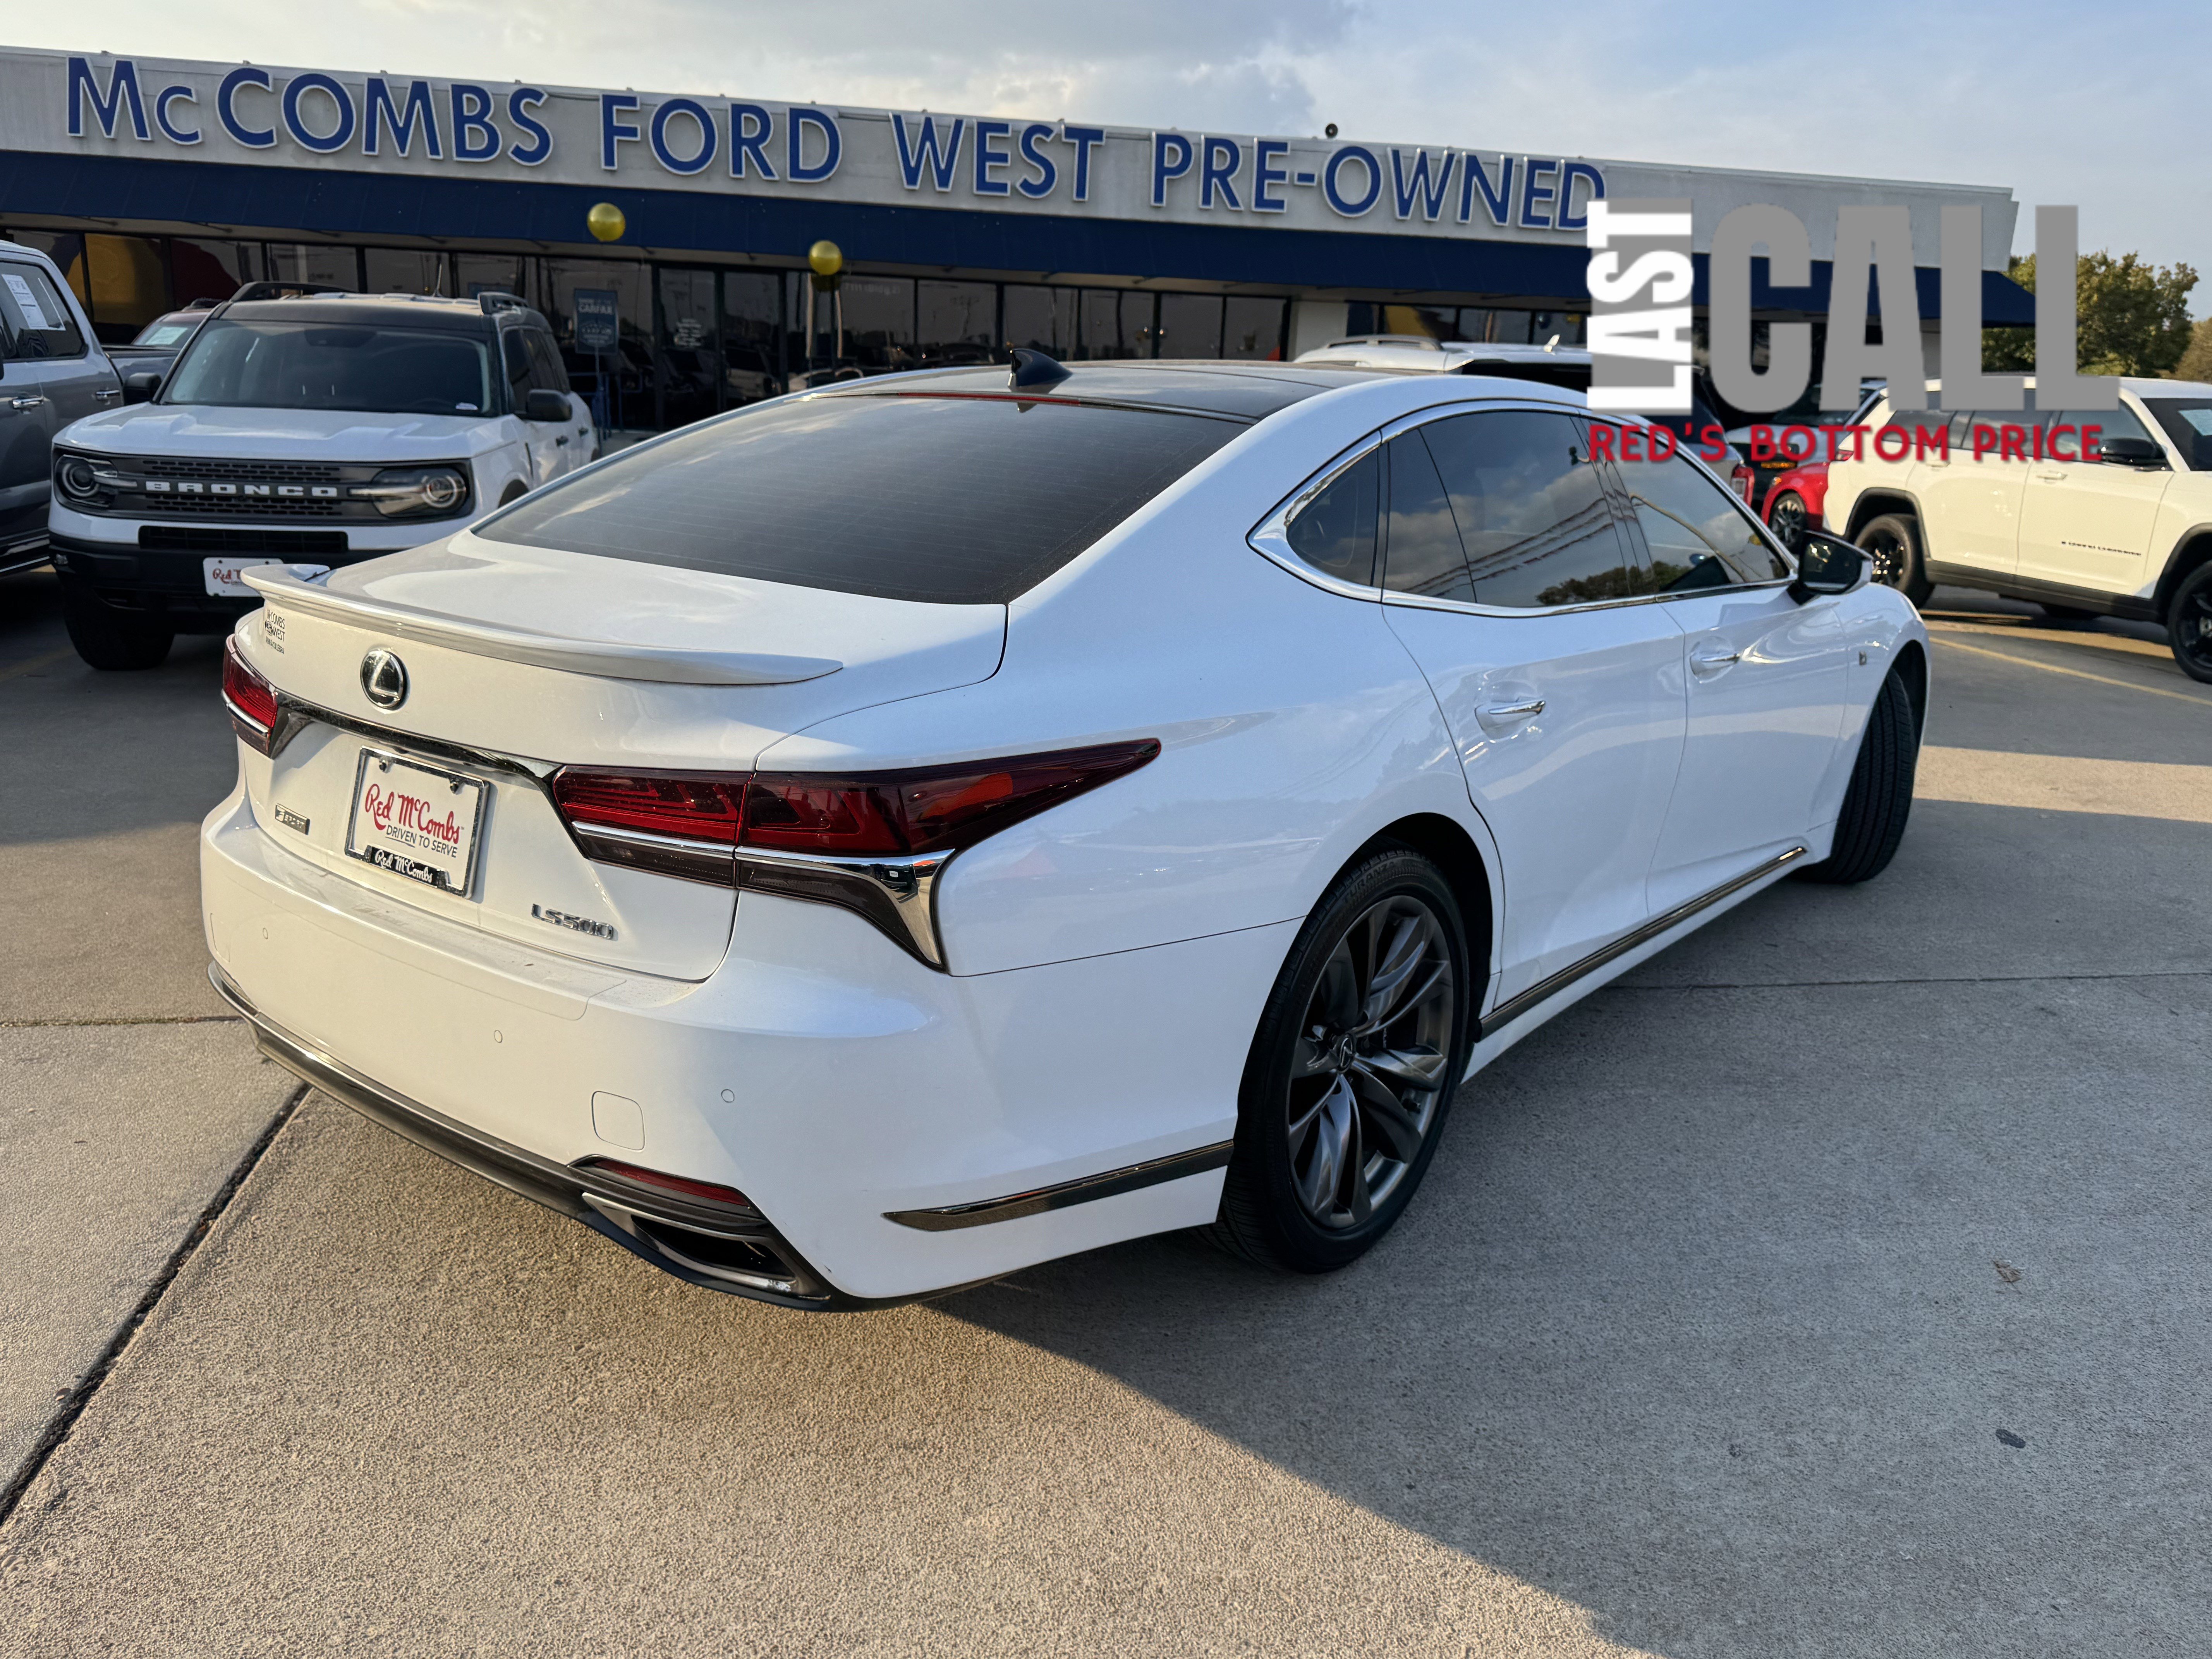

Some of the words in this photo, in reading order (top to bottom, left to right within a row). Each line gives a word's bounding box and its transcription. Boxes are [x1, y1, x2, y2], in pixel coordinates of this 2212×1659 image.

[67, 55, 553, 165] McCOMBS
[600, 93, 842, 182] FORD
[889, 112, 1105, 201] WEST
[1151, 131, 1606, 231] PRE-OWNED
[146, 480, 338, 497] BRONCO
[365, 783, 394, 830] Red
[397, 792, 460, 844] McCombs
[386, 824, 417, 845] DRIVEN
[419, 835, 430, 848] TO
[431, 840, 458, 858] SERVE
[374, 849, 392, 868] Red
[394, 856, 433, 883] McCombs
